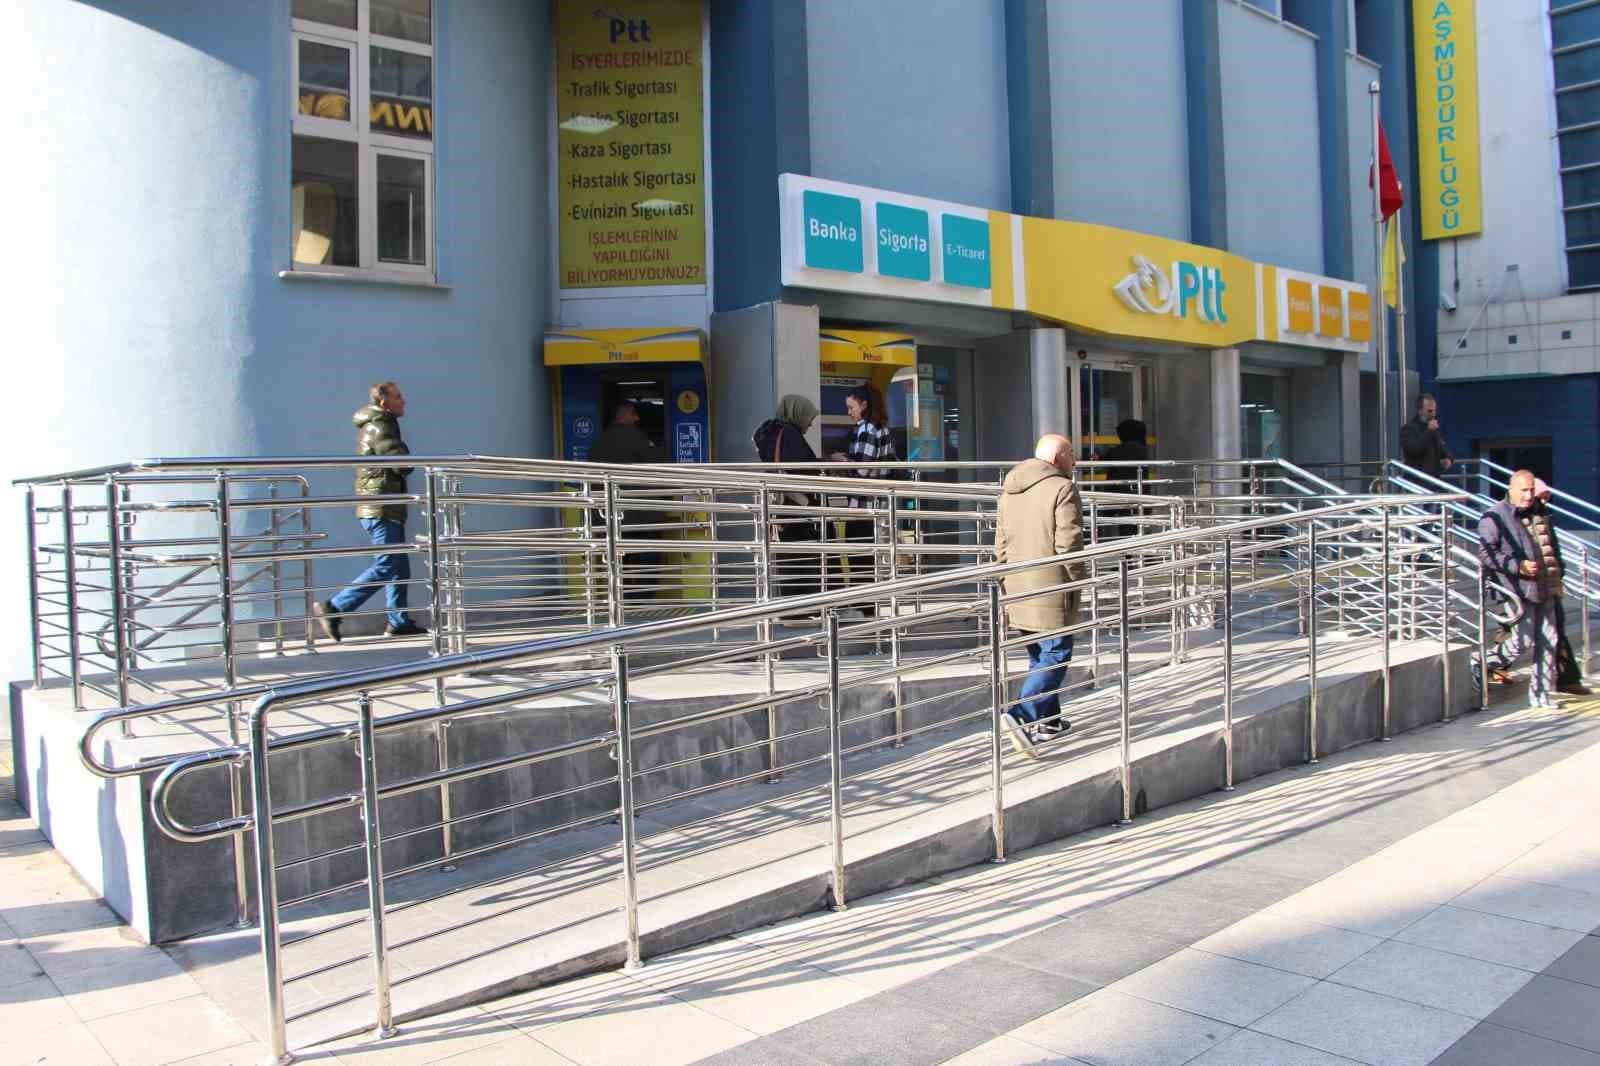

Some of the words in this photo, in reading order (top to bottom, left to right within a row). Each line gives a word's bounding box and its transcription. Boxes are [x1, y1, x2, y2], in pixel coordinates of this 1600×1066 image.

[608, 18, 652, 44] Ptt
[615, 80, 677, 98] Sigortası
[617, 110, 679, 128] Sigortası
[609, 142, 671, 160] Sigortası
[633, 171, 696, 190] Sigortası
[810, 217, 857, 242] Banka
[879, 228, 928, 253] Sigorta
[1174, 260, 1228, 324] Ptt
